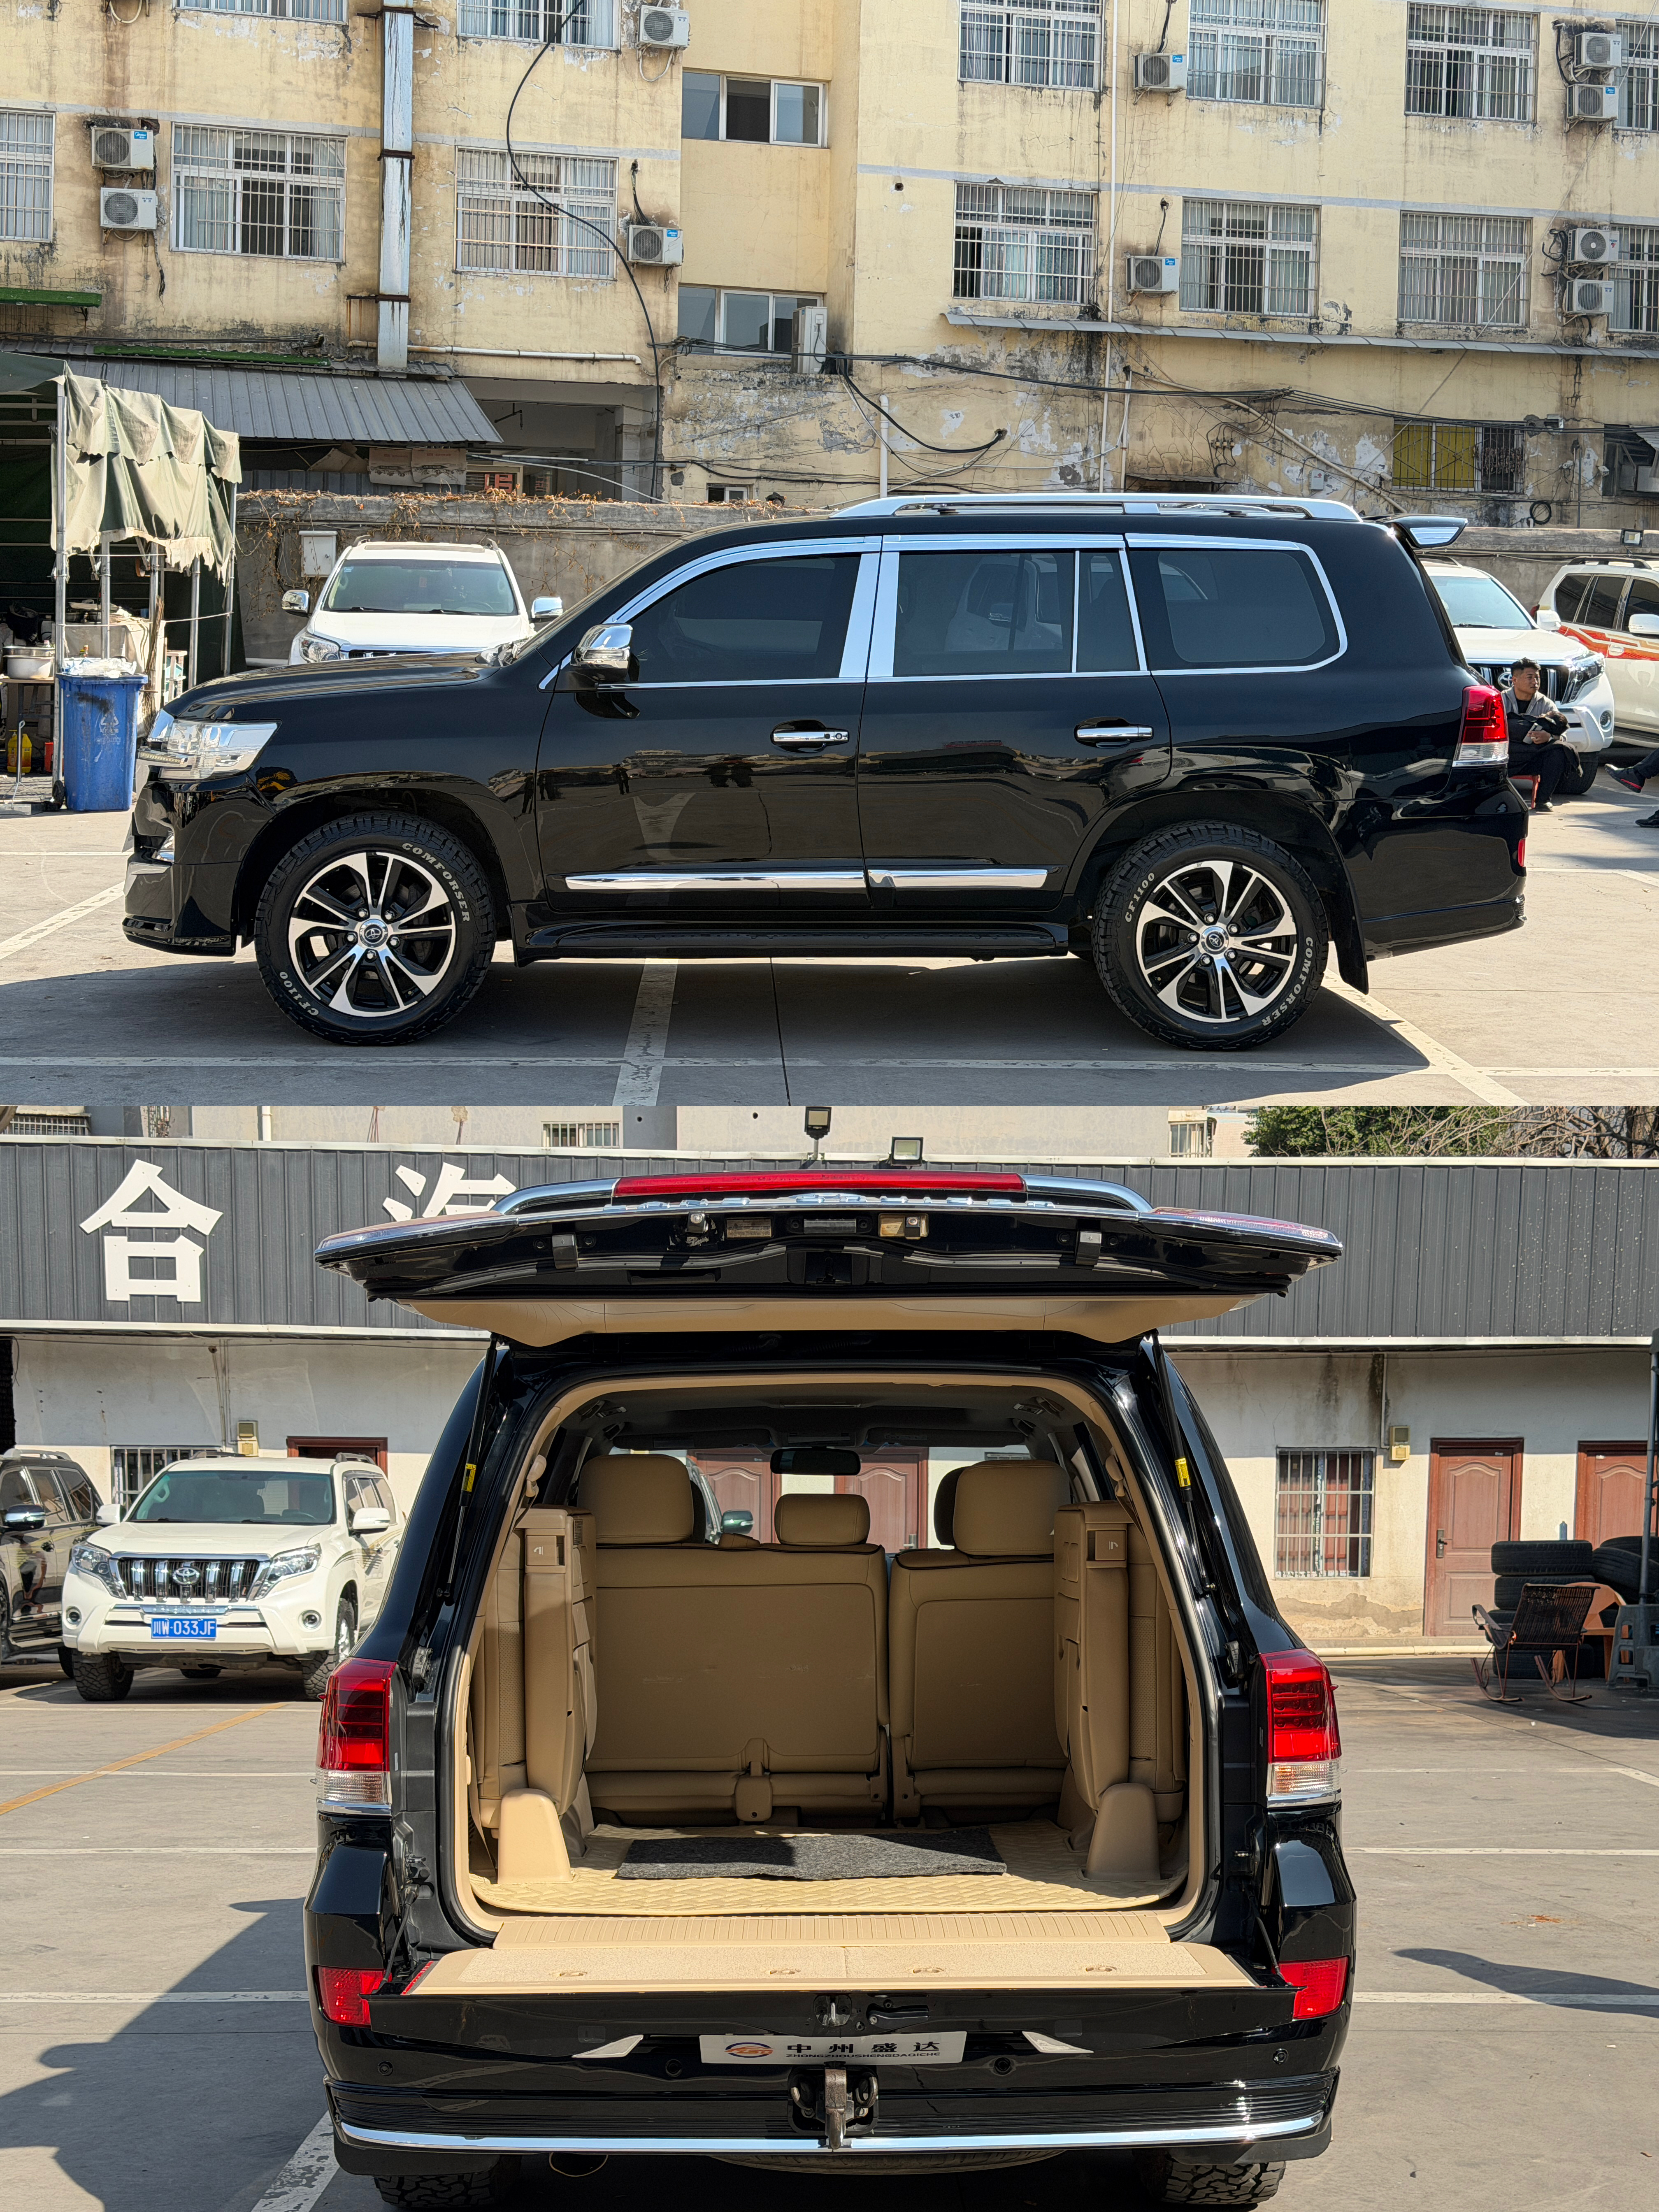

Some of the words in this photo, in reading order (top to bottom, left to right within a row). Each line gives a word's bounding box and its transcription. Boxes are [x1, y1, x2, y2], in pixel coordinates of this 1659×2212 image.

[402, 843, 470, 922] COMFORSER
[1125, 873, 1155, 922] CF1100
[279, 971, 319, 1015] CF1100
[1261, 937, 1313, 1026] COMFORSER
[787, 2041, 940, 2053] 中州盛达
